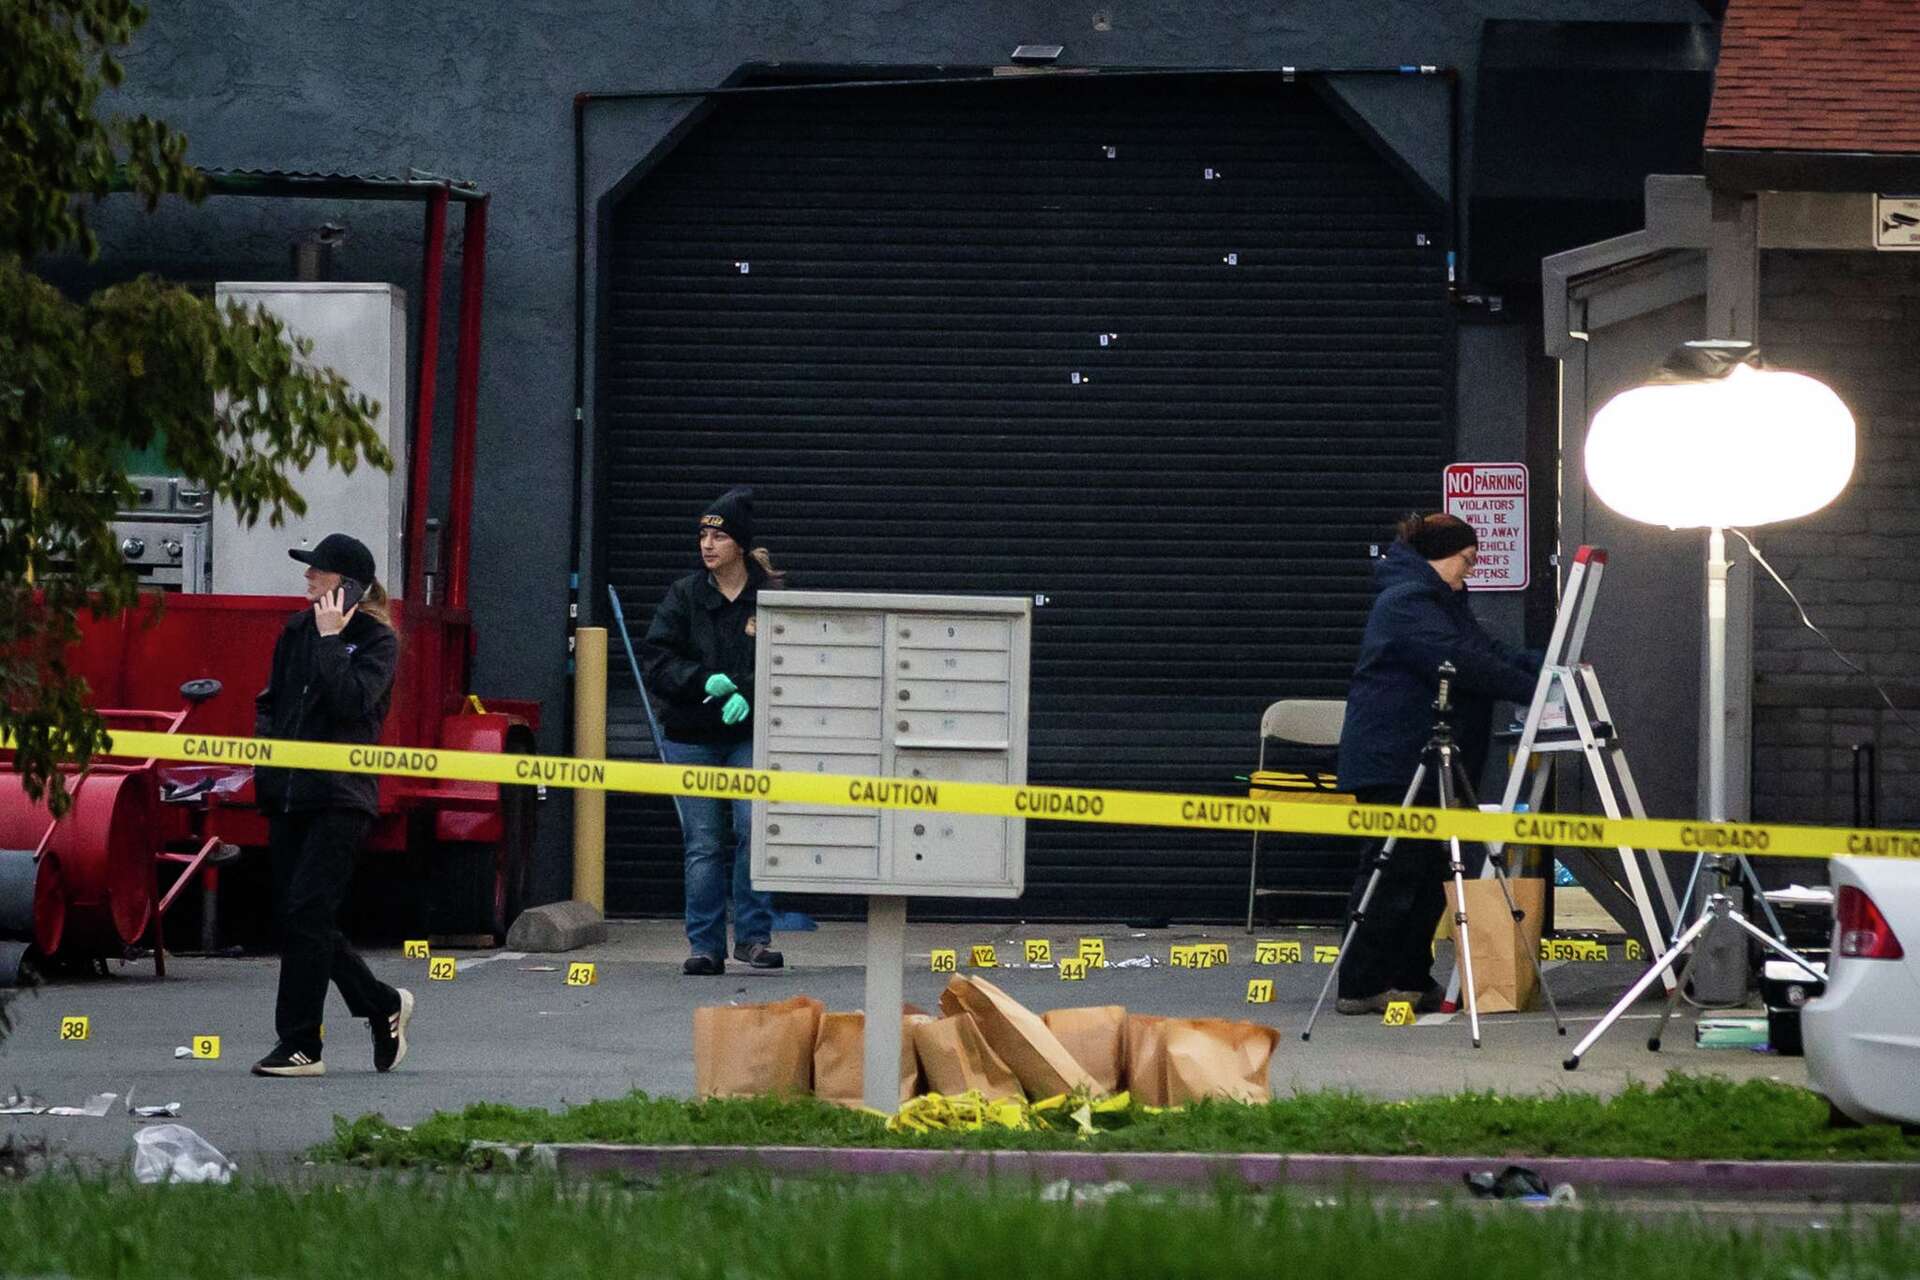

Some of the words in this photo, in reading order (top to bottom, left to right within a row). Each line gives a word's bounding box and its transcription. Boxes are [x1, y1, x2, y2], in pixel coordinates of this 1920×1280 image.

[1449, 472, 1472, 493] NO
[1475, 475, 1522, 490] PARKING
[1459, 501, 1515, 510] VIOLATORS
[1466, 514, 1489, 524] WILL
[1494, 514, 1507, 524] BE
[1491, 528, 1519, 537] AWAY
[1479, 541, 1516, 551] EHICLE
[947, 627, 955, 637] 9
[183, 738, 272, 760] CAUTION
[350, 749, 438, 771] CUIDADO
[516, 760, 605, 783] CAUTION
[682, 771, 771, 794] CUIDADO
[849, 781, 938, 805] CAUTION
[1015, 792, 1105, 815] CUIDADO
[1182, 801, 1271, 824] CAUTION
[1348, 810, 1437, 833] CUIDADO
[1514, 819, 1604, 842] CAUTION
[1680, 826, 1771, 849] CUIDADO
[1848, 834, 1920, 858] CAUTIO
[407, 946, 427, 958] 45
[1028, 945, 1048, 962] 52
[1189, 951, 1209, 968] 47
[1258, 947, 1278, 963] 73
[1279, 947, 1299, 963] 56
[1554, 944, 1573, 960] 59
[934, 955, 954, 970] 46
[431, 966, 452, 979] 42
[569, 968, 590, 984] 43
[1062, 964, 1083, 977] 44
[1250, 985, 1267, 1000] 41
[1385, 1007, 1404, 1024] 36
[63, 1022, 84, 1040] 38
[201, 1041, 212, 1054] 9
